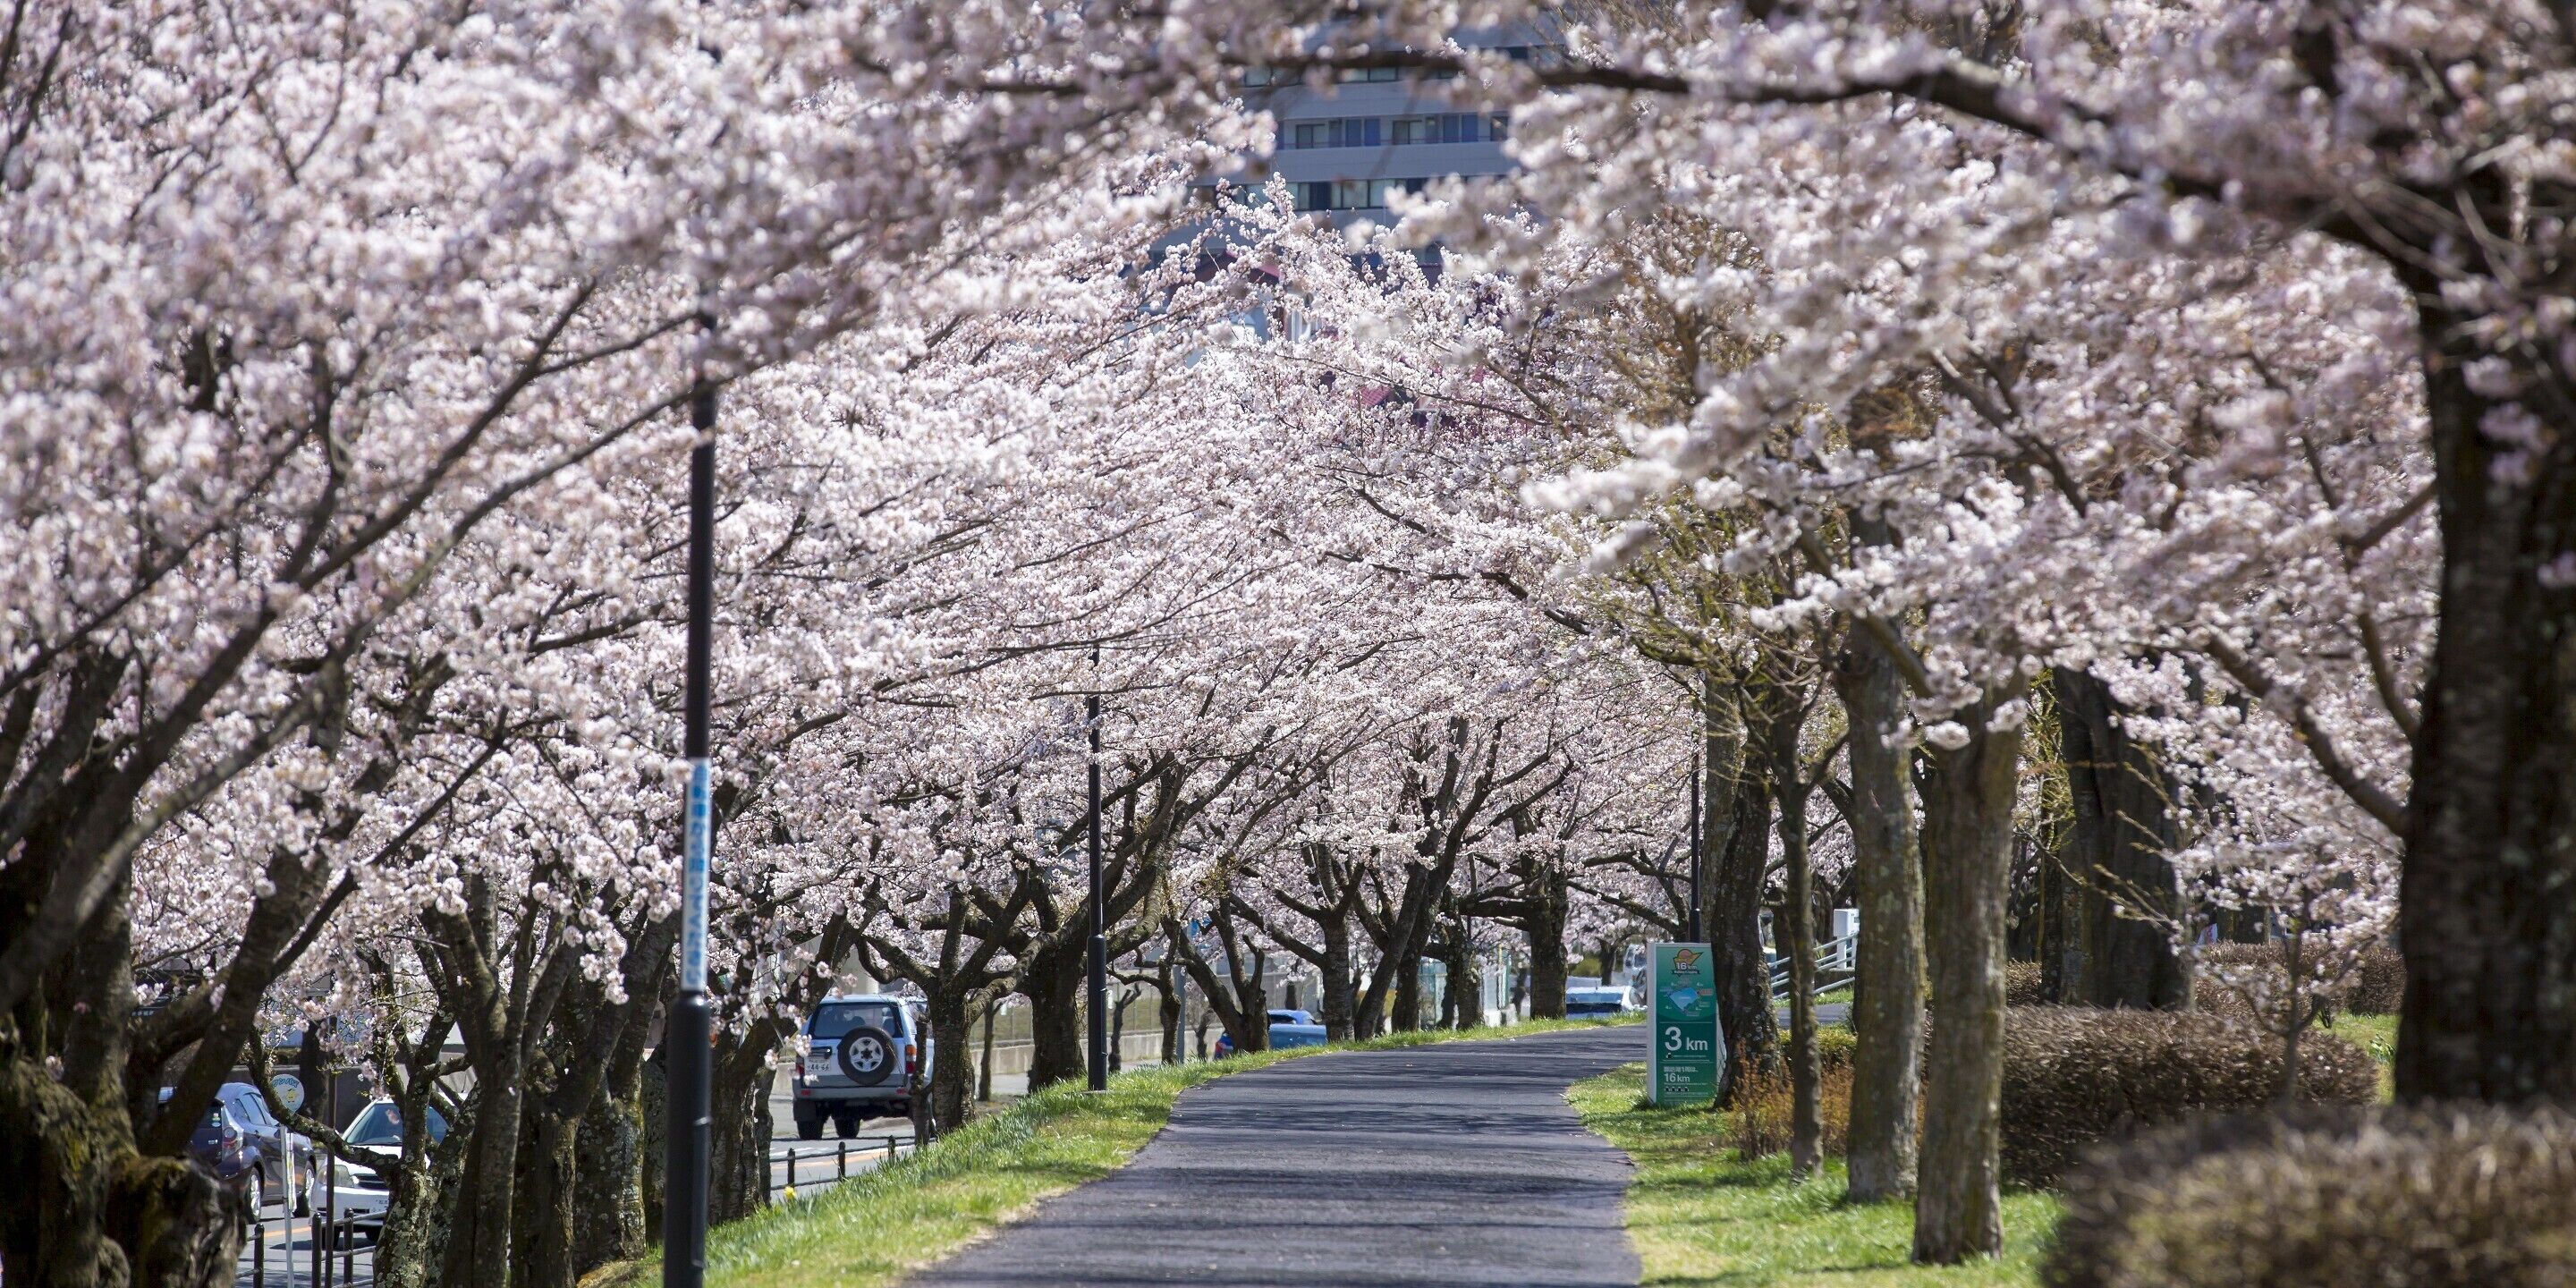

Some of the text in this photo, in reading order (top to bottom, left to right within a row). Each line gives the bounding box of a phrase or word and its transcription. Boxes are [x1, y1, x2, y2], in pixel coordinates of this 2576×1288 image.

[1675, 962, 1687, 970] 16
[1665, 1027, 1708, 1051] 3 km
[1664, 1073, 1676, 1082] 16
